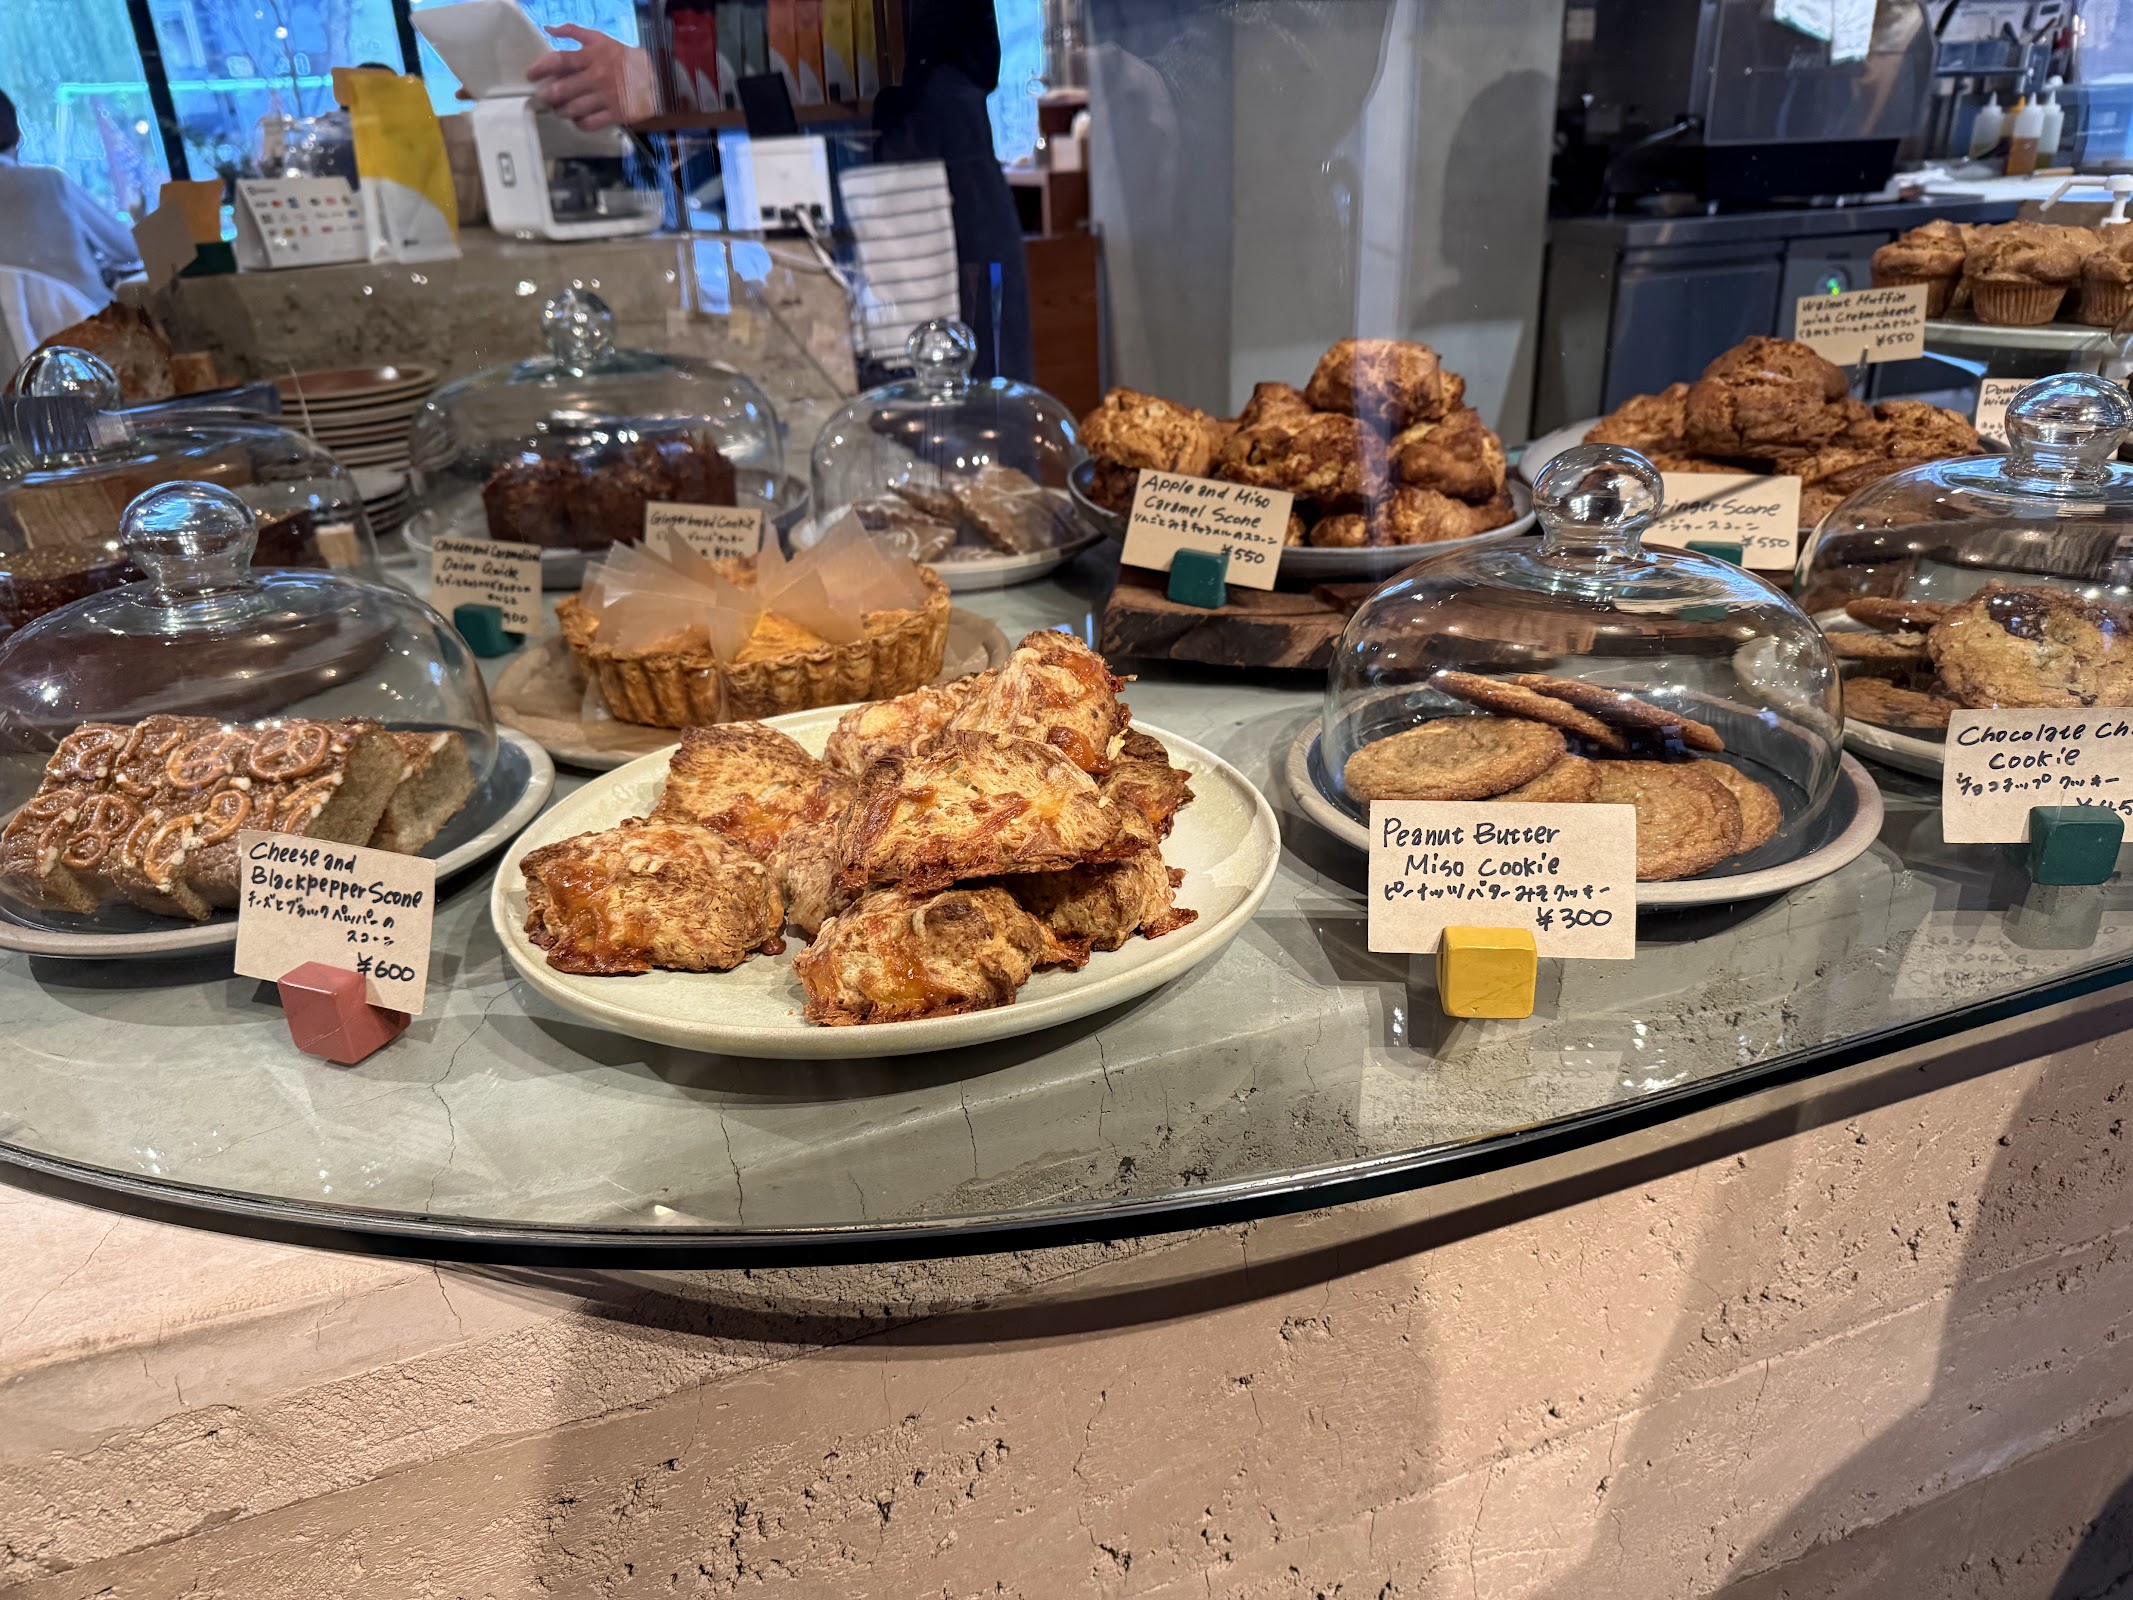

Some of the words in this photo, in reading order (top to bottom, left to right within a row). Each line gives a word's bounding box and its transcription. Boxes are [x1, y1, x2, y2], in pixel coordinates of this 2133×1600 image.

[1802, 298, 1850, 311] Walnut
[1856, 292, 1906, 305] Muffin
[1876, 332, 1915, 347] ¥550
[1142, 475, 1195, 494] Apple
[1197, 486, 1230, 499] and
[1234, 488, 1271, 509] Miso
[1144, 496, 1206, 518] Caramel
[1212, 507, 1262, 528] Scone
[1723, 499, 1781, 516] Scone
[1220, 544, 1265, 564] ¥550
[1741, 535, 1790, 549] ¥550
[1957, 724, 2087, 746] Chocolate
[2095, 721, 2133, 739] Ch
[1989, 747, 2080, 770] Cookie
[1383, 817, 1464, 848] Peanut
[1473, 822, 1560, 845] Butter
[249, 842, 320, 867] Cheese
[324, 854, 357, 874] and
[1404, 853, 1464, 876] Miso
[1478, 853, 1560, 877] Cookie
[251, 866, 366, 900] Blackpepper
[367, 882, 423, 908] Scone
[1536, 907, 1612, 931] ¥300
[347, 930, 395, 946] スコーン
[357, 952, 415, 982] ¥600
